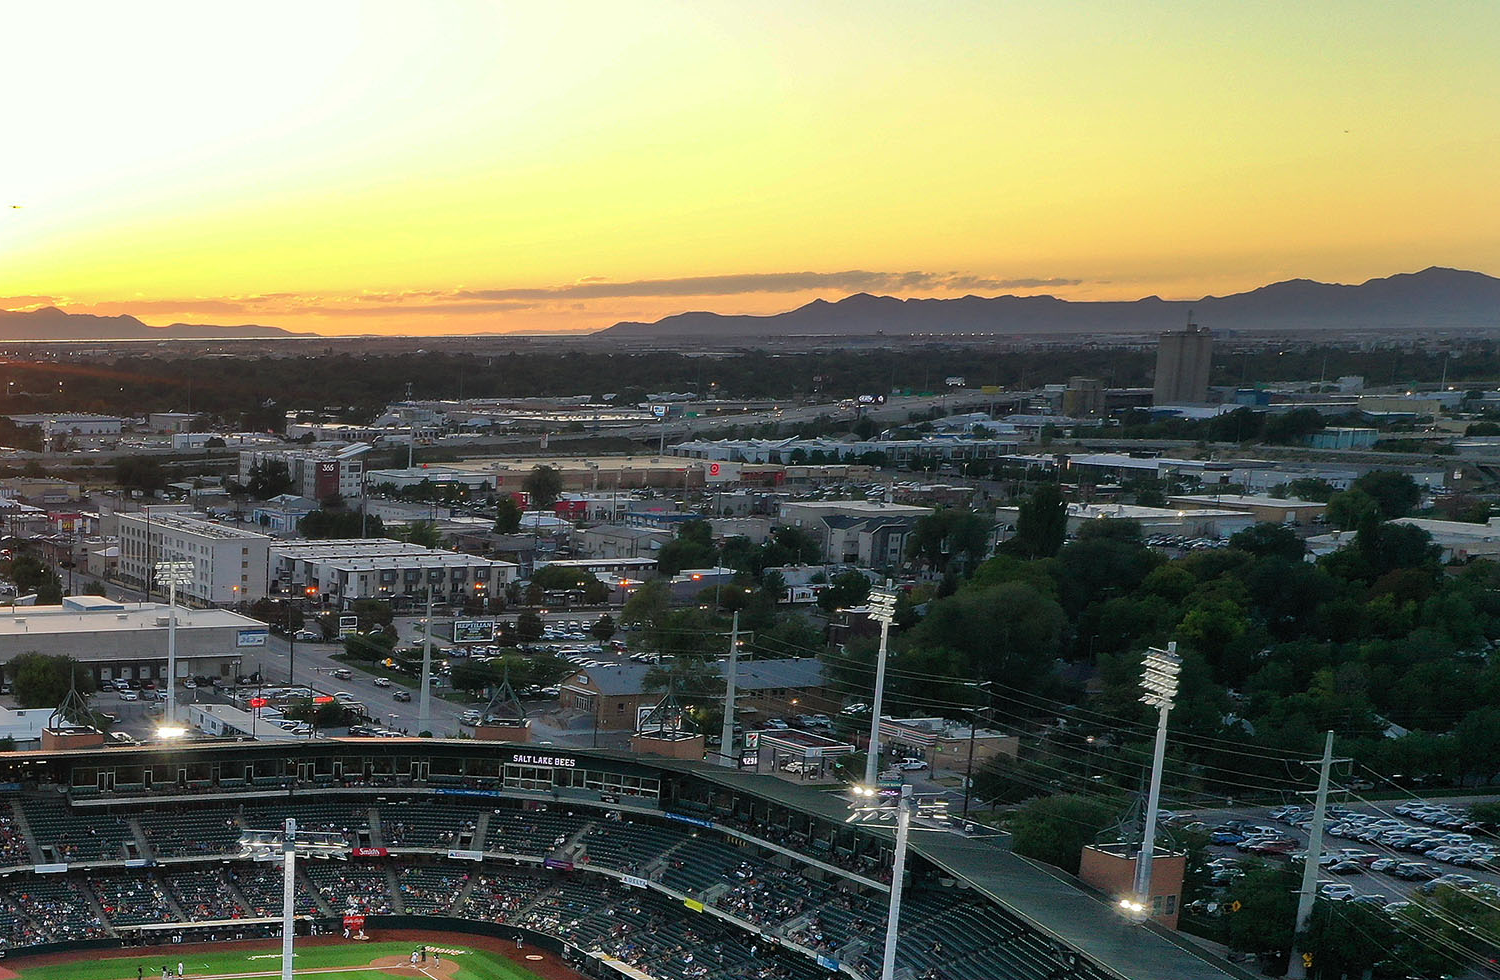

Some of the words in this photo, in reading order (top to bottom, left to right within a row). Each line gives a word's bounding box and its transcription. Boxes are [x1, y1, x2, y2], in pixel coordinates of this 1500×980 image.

[513, 754, 532, 763] SALT
[533, 756, 553, 765] LAKE
[554, 758, 576, 767] BEES
